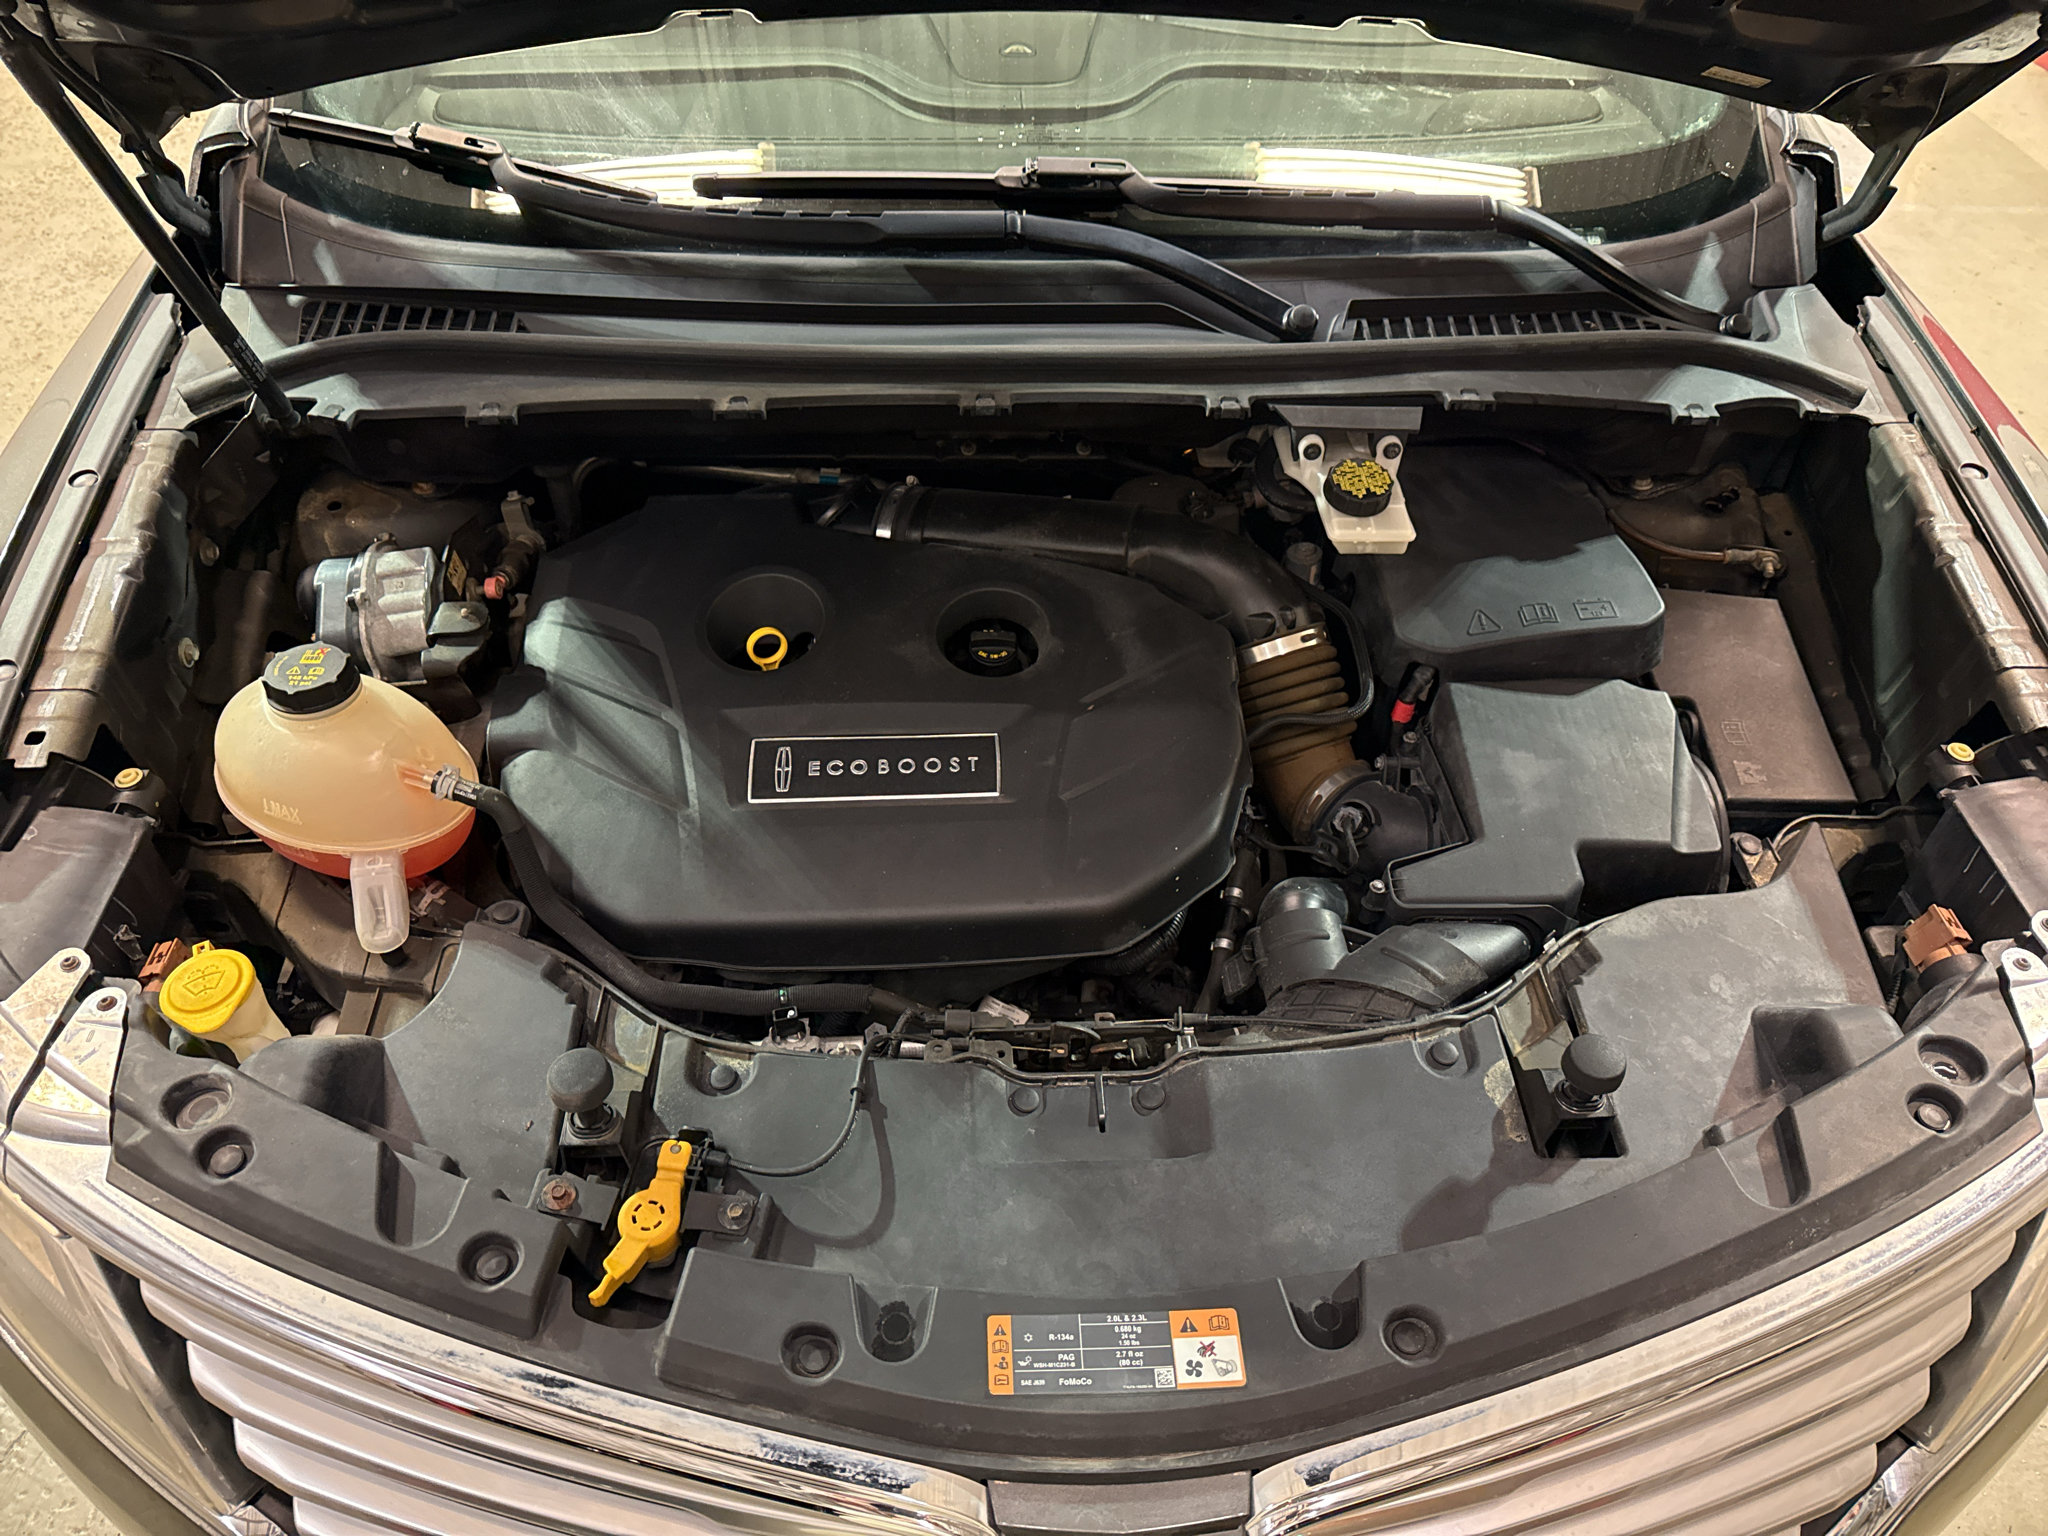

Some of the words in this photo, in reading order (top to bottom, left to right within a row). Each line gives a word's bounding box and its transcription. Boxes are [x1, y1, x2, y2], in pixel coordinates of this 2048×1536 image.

[808, 756, 979, 776] ECOBOOST
[1133, 1325, 1142, 1333] kg
[1048, 1333, 1074, 1341] R-134a
[1057, 1353, 1075, 1361] PAG
[1119, 1359, 1130, 1367] (80
[1059, 1377, 1093, 1386] FoMoCo
